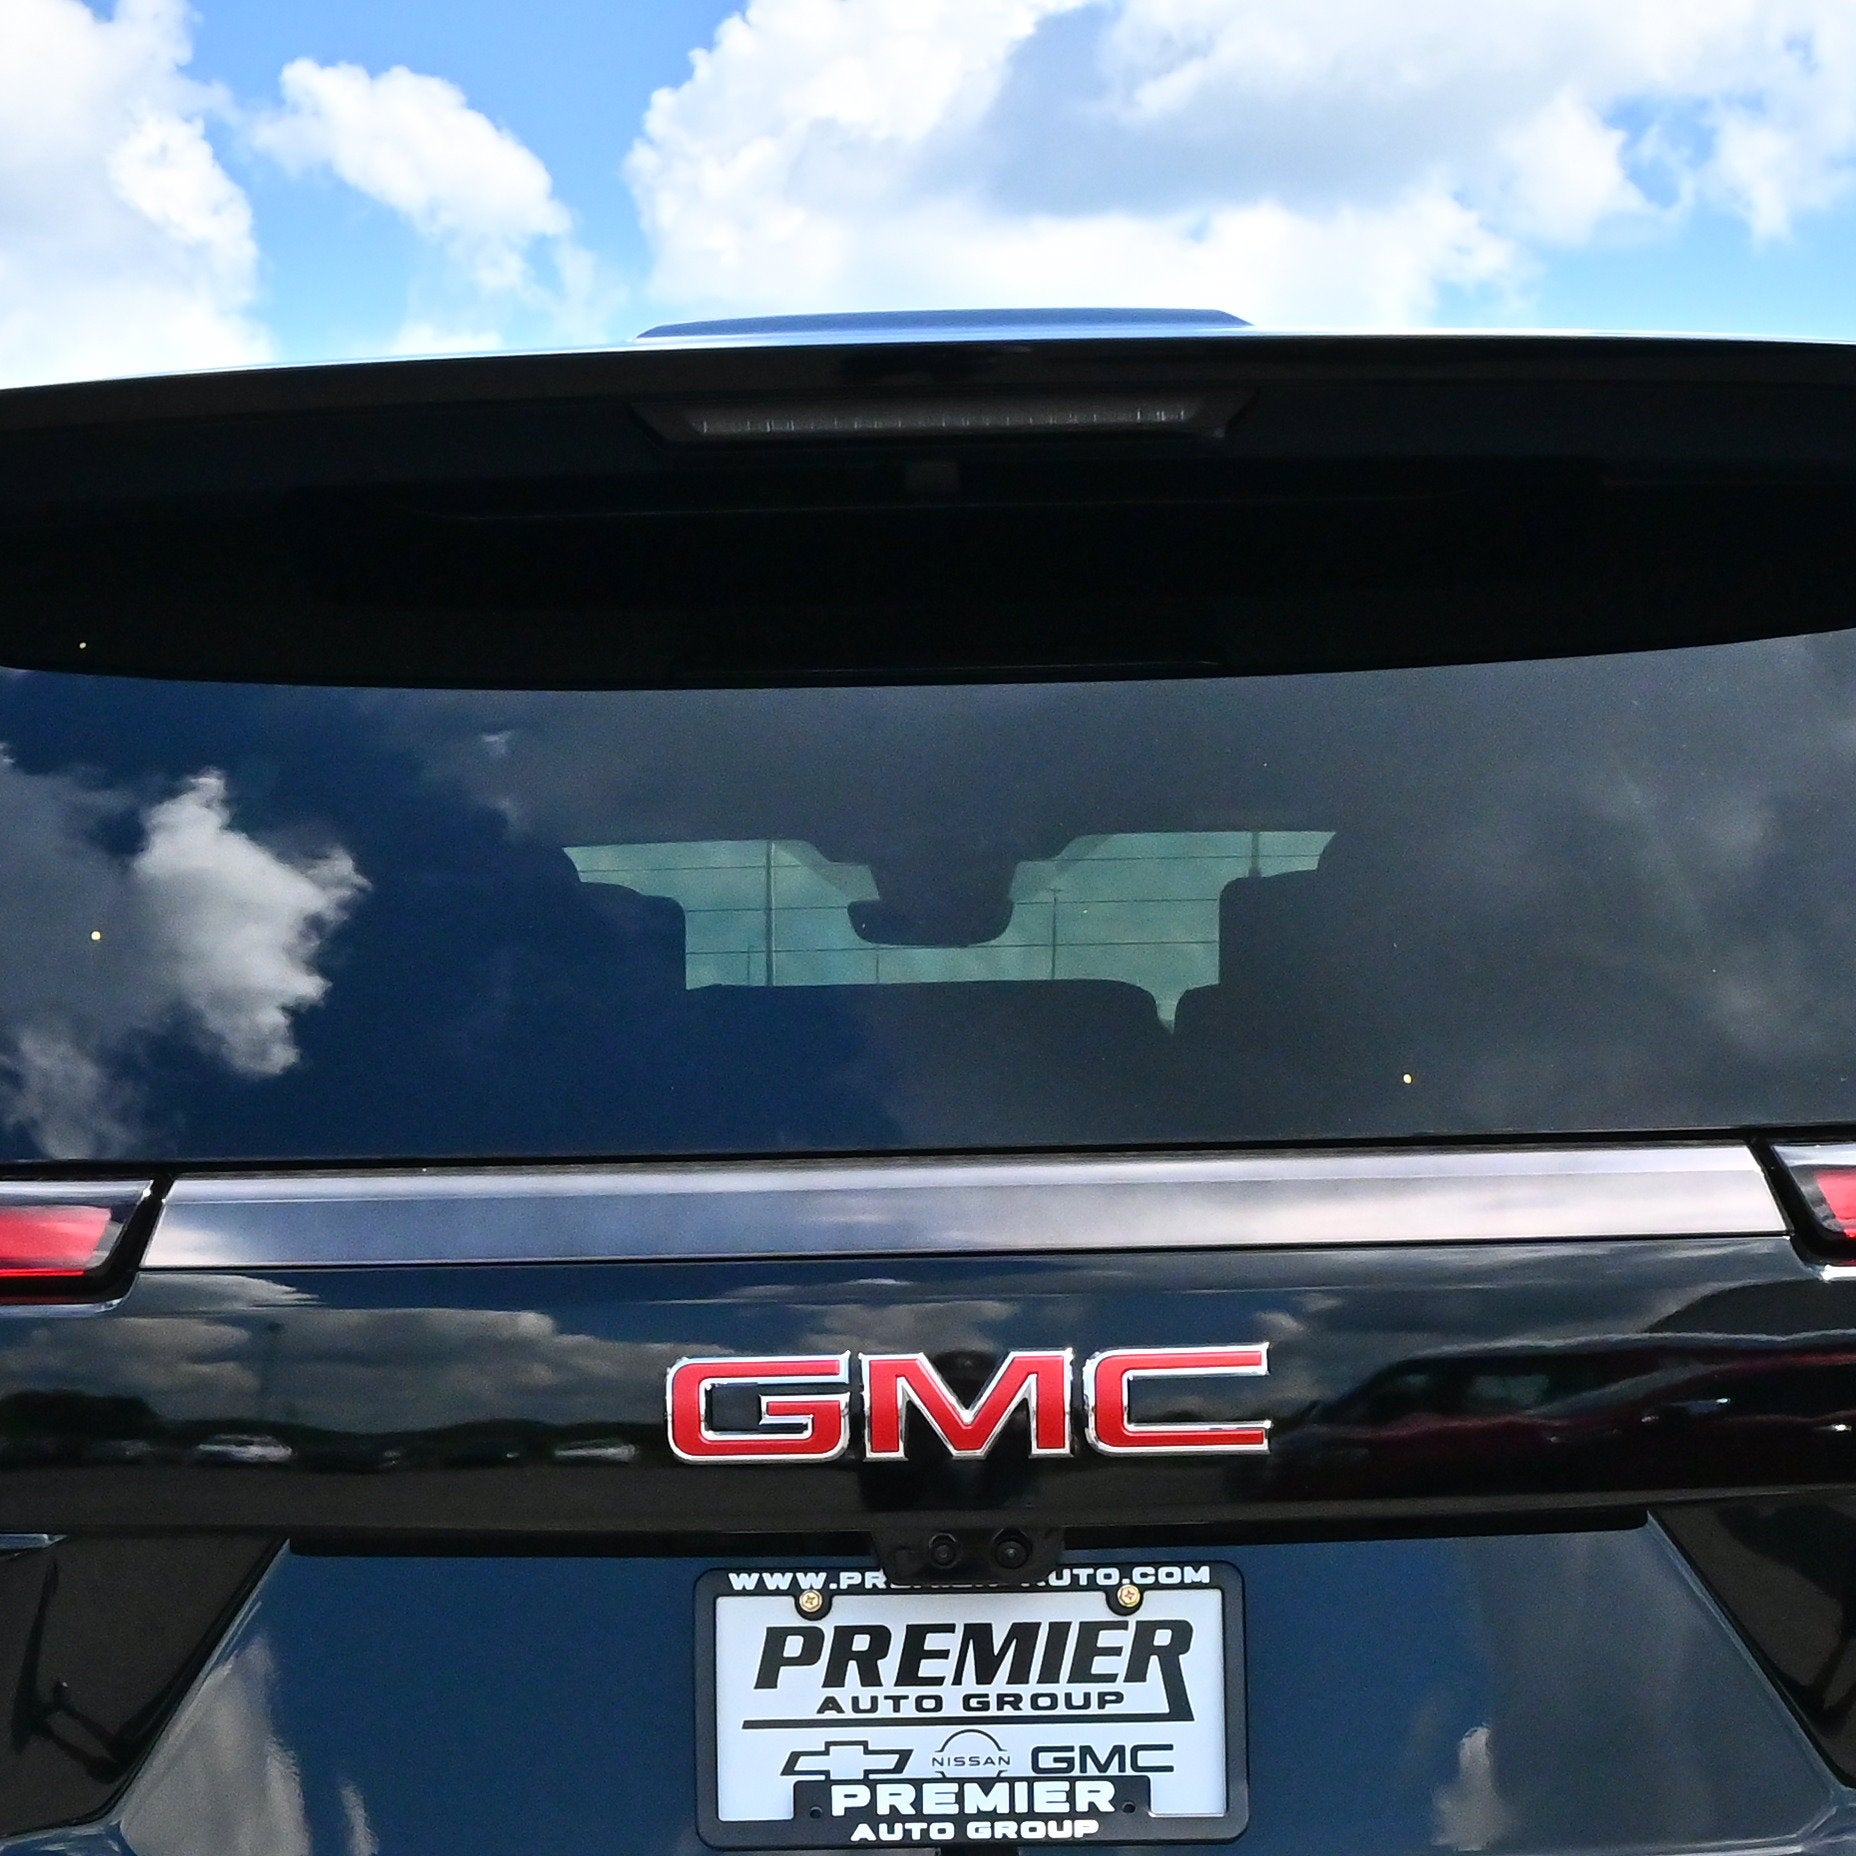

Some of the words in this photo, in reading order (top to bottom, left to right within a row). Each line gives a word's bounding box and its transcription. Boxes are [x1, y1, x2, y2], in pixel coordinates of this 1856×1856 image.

[665, 1342, 1271, 1463] GMC
[752, 1618, 1196, 1706] PREMIER
[816, 1694, 944, 1715] AUTO
[962, 1691, 1125, 1712] GROUP
[932, 1754, 1012, 1768] NISSAN
[1029, 1743, 1175, 1775] GMC
[830, 1780, 1117, 1818] PREMIER
[849, 1821, 957, 1843] AUTO
[966, 1819, 1101, 1841] GROUP
